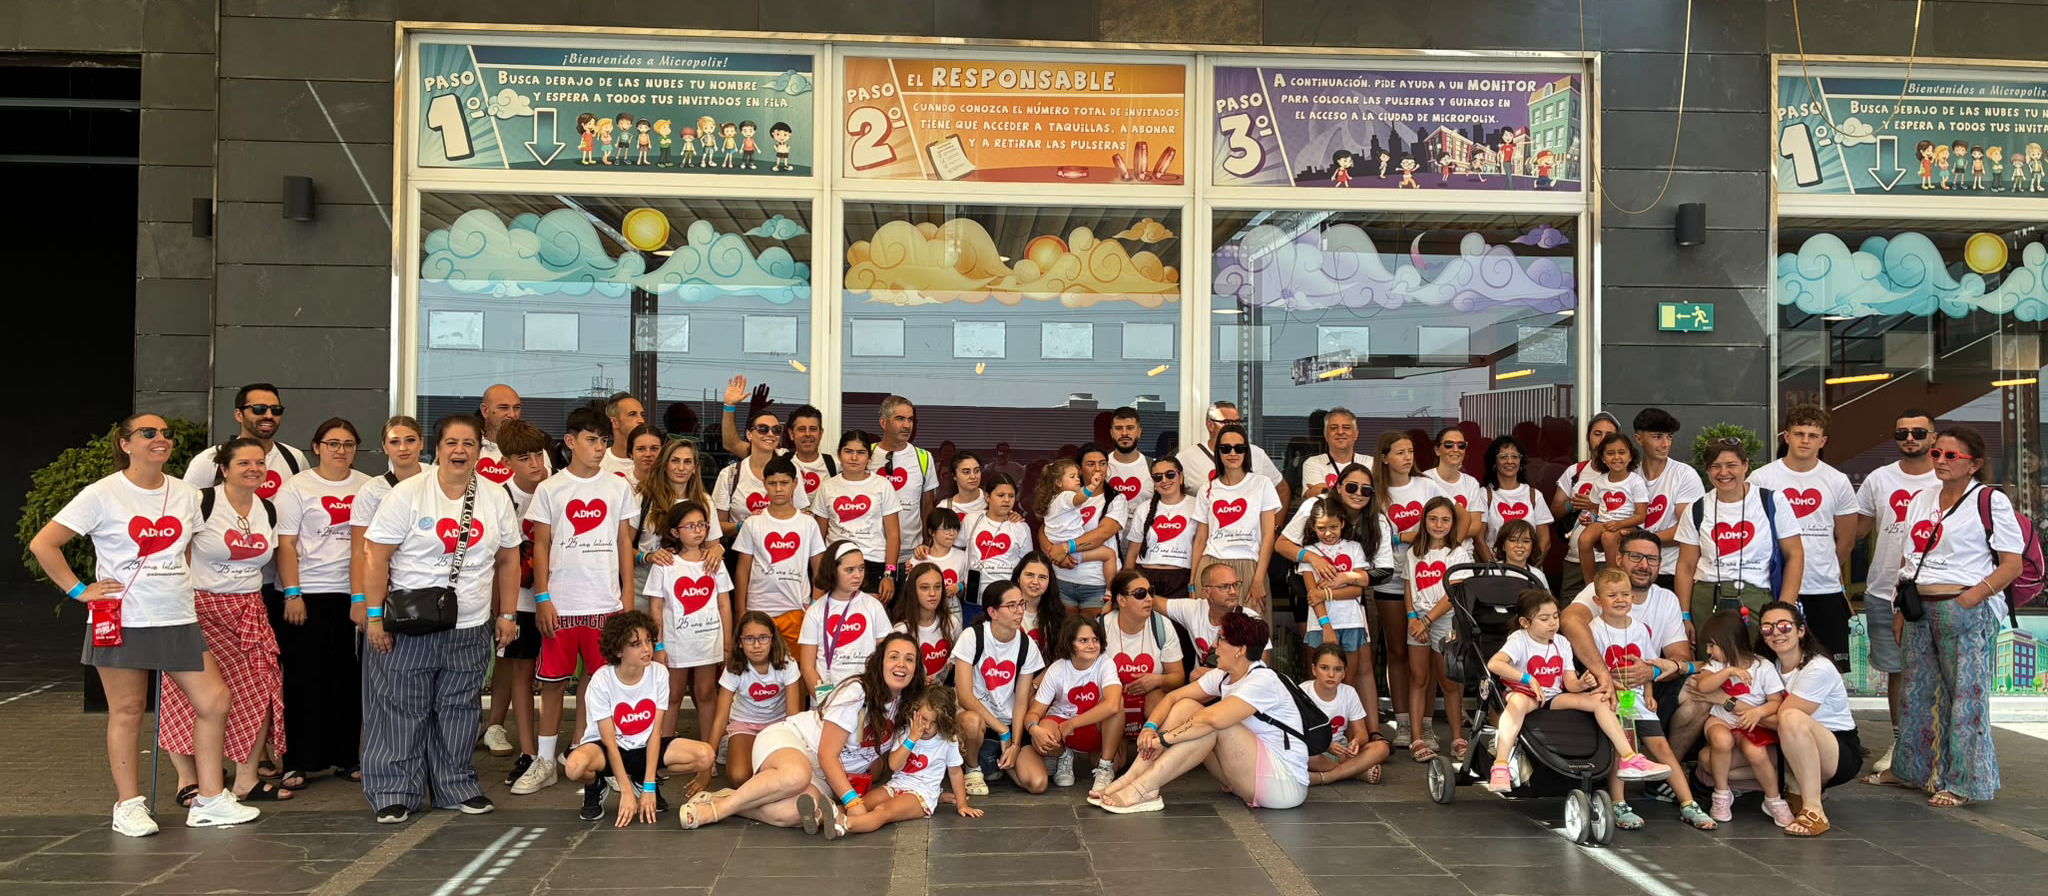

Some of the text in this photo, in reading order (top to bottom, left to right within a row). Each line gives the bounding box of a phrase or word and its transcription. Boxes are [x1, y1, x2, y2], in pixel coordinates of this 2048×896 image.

[562, 52, 729, 69] ¡Bienvenidos a Micropolix!
[424, 70, 475, 93] PASO
[498, 70, 757, 91] BUSCA DEBAJO DE LAS NUBES TU NOMBRE
[907, 74, 924, 87] EL
[1273, 73, 1287, 88] A
[1400, 80, 1435, 89] AYUDA
[1438, 80, 1446, 89] A
[1450, 81, 1464, 90] UN
[846, 83, 895, 104] PASO
[1904, 83, 2048, 99] Bienvenidos a Micropolix
[533, 92, 542, 102] Y
[546, 92, 589, 103] ESPERA
[593, 94, 602, 103] A
[606, 94, 646, 104] TODOS
[651, 95, 674, 105] TUS
[746, 97, 760, 107] EN
[1216, 92, 1263, 113] PASO
[1281, 94, 1309, 104] PARA
[1312, 95, 1359, 105] COLOCAR
[1363, 96, 1381, 105] LAS
[1385, 97, 1435, 106] PULSERAS
[1438, 97, 1446, 106] Y
[1498, 99, 1511, 108] EN
[913, 103, 956, 113] CUANDO
[960, 104, 1009, 114] CONOZCA
[1012, 105, 1023, 114] EL
[1026, 102, 1069, 115] NÚMERO
[1074, 107, 1107, 116] TOTAL
[1110, 107, 1121, 116] DE
[1778, 101, 1822, 122] PASO
[1850, 100, 1889, 114] BUSCA
[1894, 105, 1938, 115] DEBAJO
[1942, 106, 1955, 115] DE
[1960, 107, 1980, 116] LAS
[1984, 107, 2019, 117] NUBES
[2024, 108, 2039, 118] TU
[1295, 111, 1305, 120] EL
[1309, 111, 1347, 120] ACCESO
[1351, 112, 1359, 120] A
[1362, 112, 1375, 121] LA
[1417, 113, 1428, 122] DE
[955, 120, 978, 130] QUE
[983, 121, 1029, 131] ACCEDER
[1034, 122, 1042, 131] A
[1120, 124, 1128, 133] A
[1132, 125, 1175, 134] ABONAR
[1894, 121, 1934, 130] ESPERA
[1938, 122, 1945, 131] A
[1949, 122, 1986, 131] TODOS
[1990, 123, 2011, 132] TUS
[968, 138, 976, 148] Y
[982, 138, 990, 148] A
[1046, 139, 1066, 149] LAS
[1070, 140, 1126, 150] PULSERAS
[885, 475, 904, 483] DMO
[329, 502, 352, 510] ADM
[752, 500, 771, 508] ADM
[837, 502, 867, 511] ADMO
[1788, 497, 1816, 506] ADMO
[572, 508, 601, 519] ADMO
[1217, 505, 1242, 514] ADMO
[1394, 508, 1420, 519] ADMO
[1500, 508, 1525, 516] ADMO
[1156, 522, 1182, 531] ADMO
[443, 528, 479, 538] ADO
[770, 540, 797, 549] ADMO
[1416, 570, 1441, 579] ADMO
[681, 587, 709, 597] ADMO
[925, 649, 948, 661] ADMO
[1119, 662, 1148, 673] ADMO
[985, 669, 1011, 679] ADMO
[753, 689, 777, 697] ADMO
[620, 710, 651, 725] ADMO
